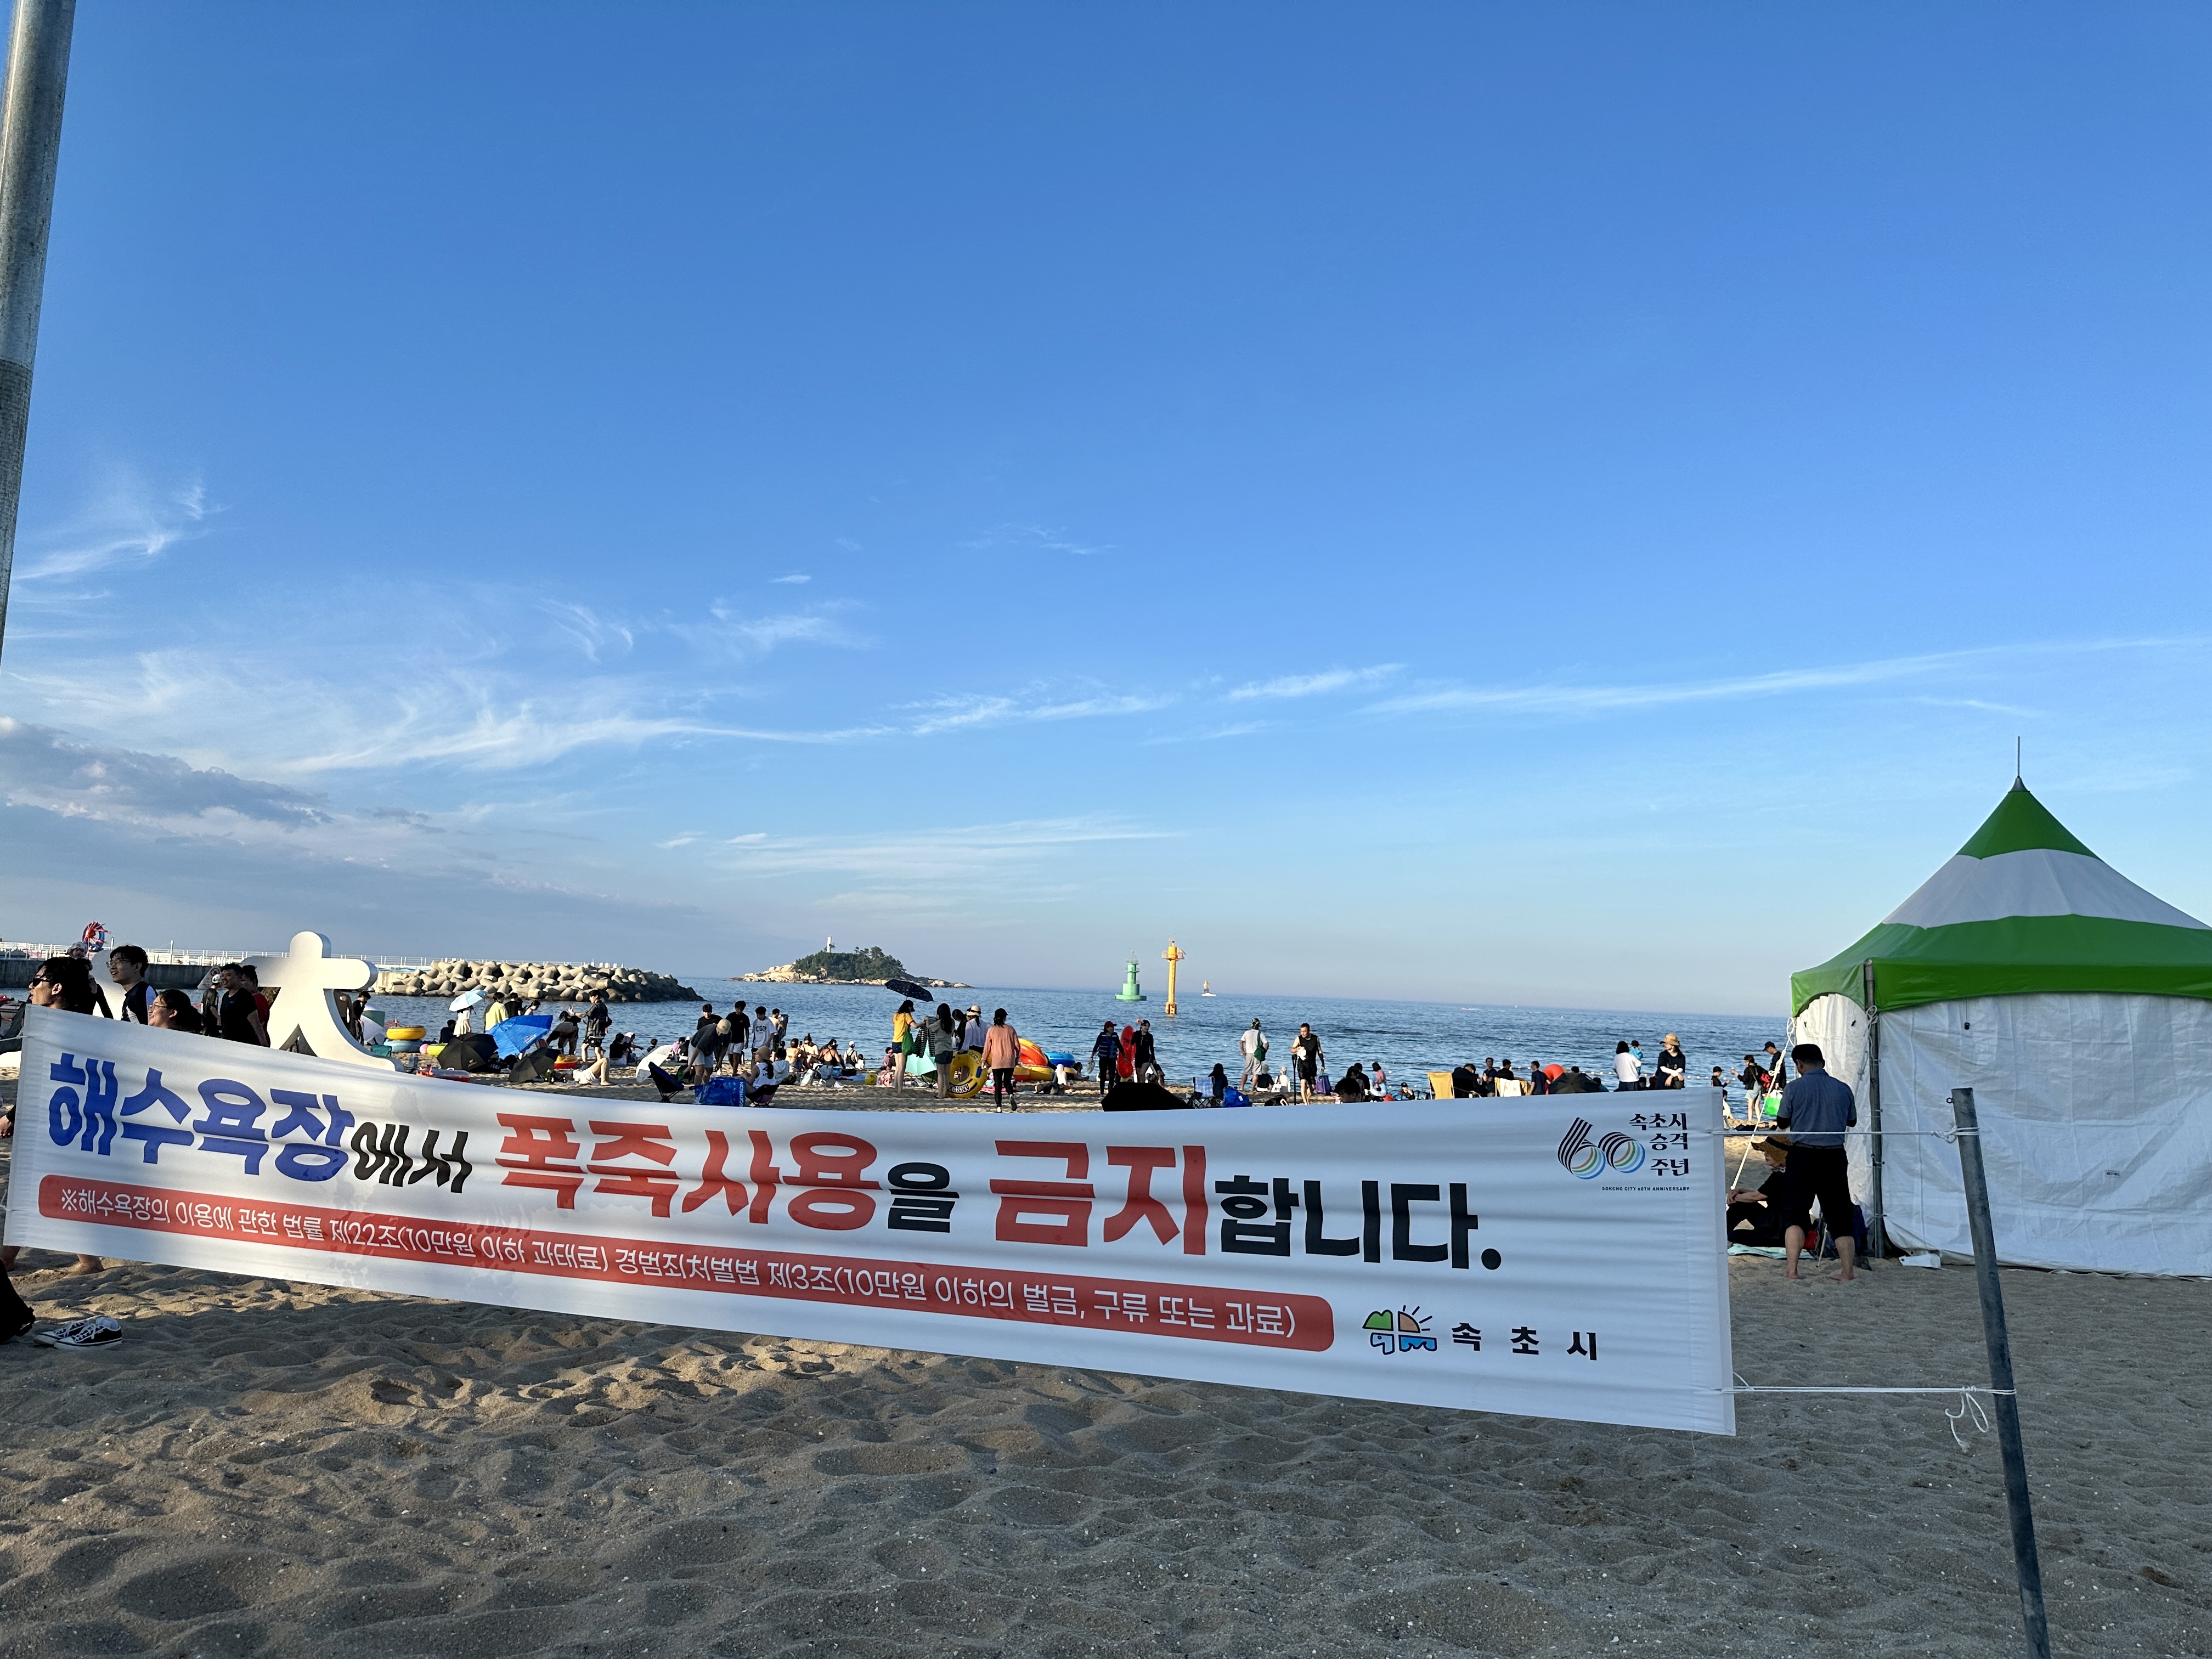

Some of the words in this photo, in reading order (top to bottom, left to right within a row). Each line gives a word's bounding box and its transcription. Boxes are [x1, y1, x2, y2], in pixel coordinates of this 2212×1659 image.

[1629, 1113, 1688, 1131] 속초시
[1649, 1132, 1688, 1150] 승격
[49, 1053, 473, 1194] 해수욕장에서
[495, 1113, 960, 1233] 폭죽사용을
[990, 1140, 1501, 1270] 금지합니다.
[1558, 1117, 1646, 1180] 60
[1650, 1158, 1689, 1176] 주년
[175, 1201, 234, 1231] 이용에
[239, 1209, 279, 1237] 관한
[283, 1214, 325, 1241] 법률
[329, 1219, 476, 1257] 제22조(10만원
[481, 1235, 525, 1263] 이하
[531, 1240, 608, 1272] 과태료)
[615, 1248, 760, 1285] 경범죄처벌법
[767, 1261, 927, 1301] 제3조(10만원
[935, 1276, 1014, 1310] 이하의
[1024, 1284, 1085, 1319] 벌금,
[1094, 1289, 1149, 1323] 구류
[1159, 1296, 1215, 1329] 또는
[1226, 1301, 1295, 1338] 과료)
[1451, 1322, 1597, 1361] 속초시
